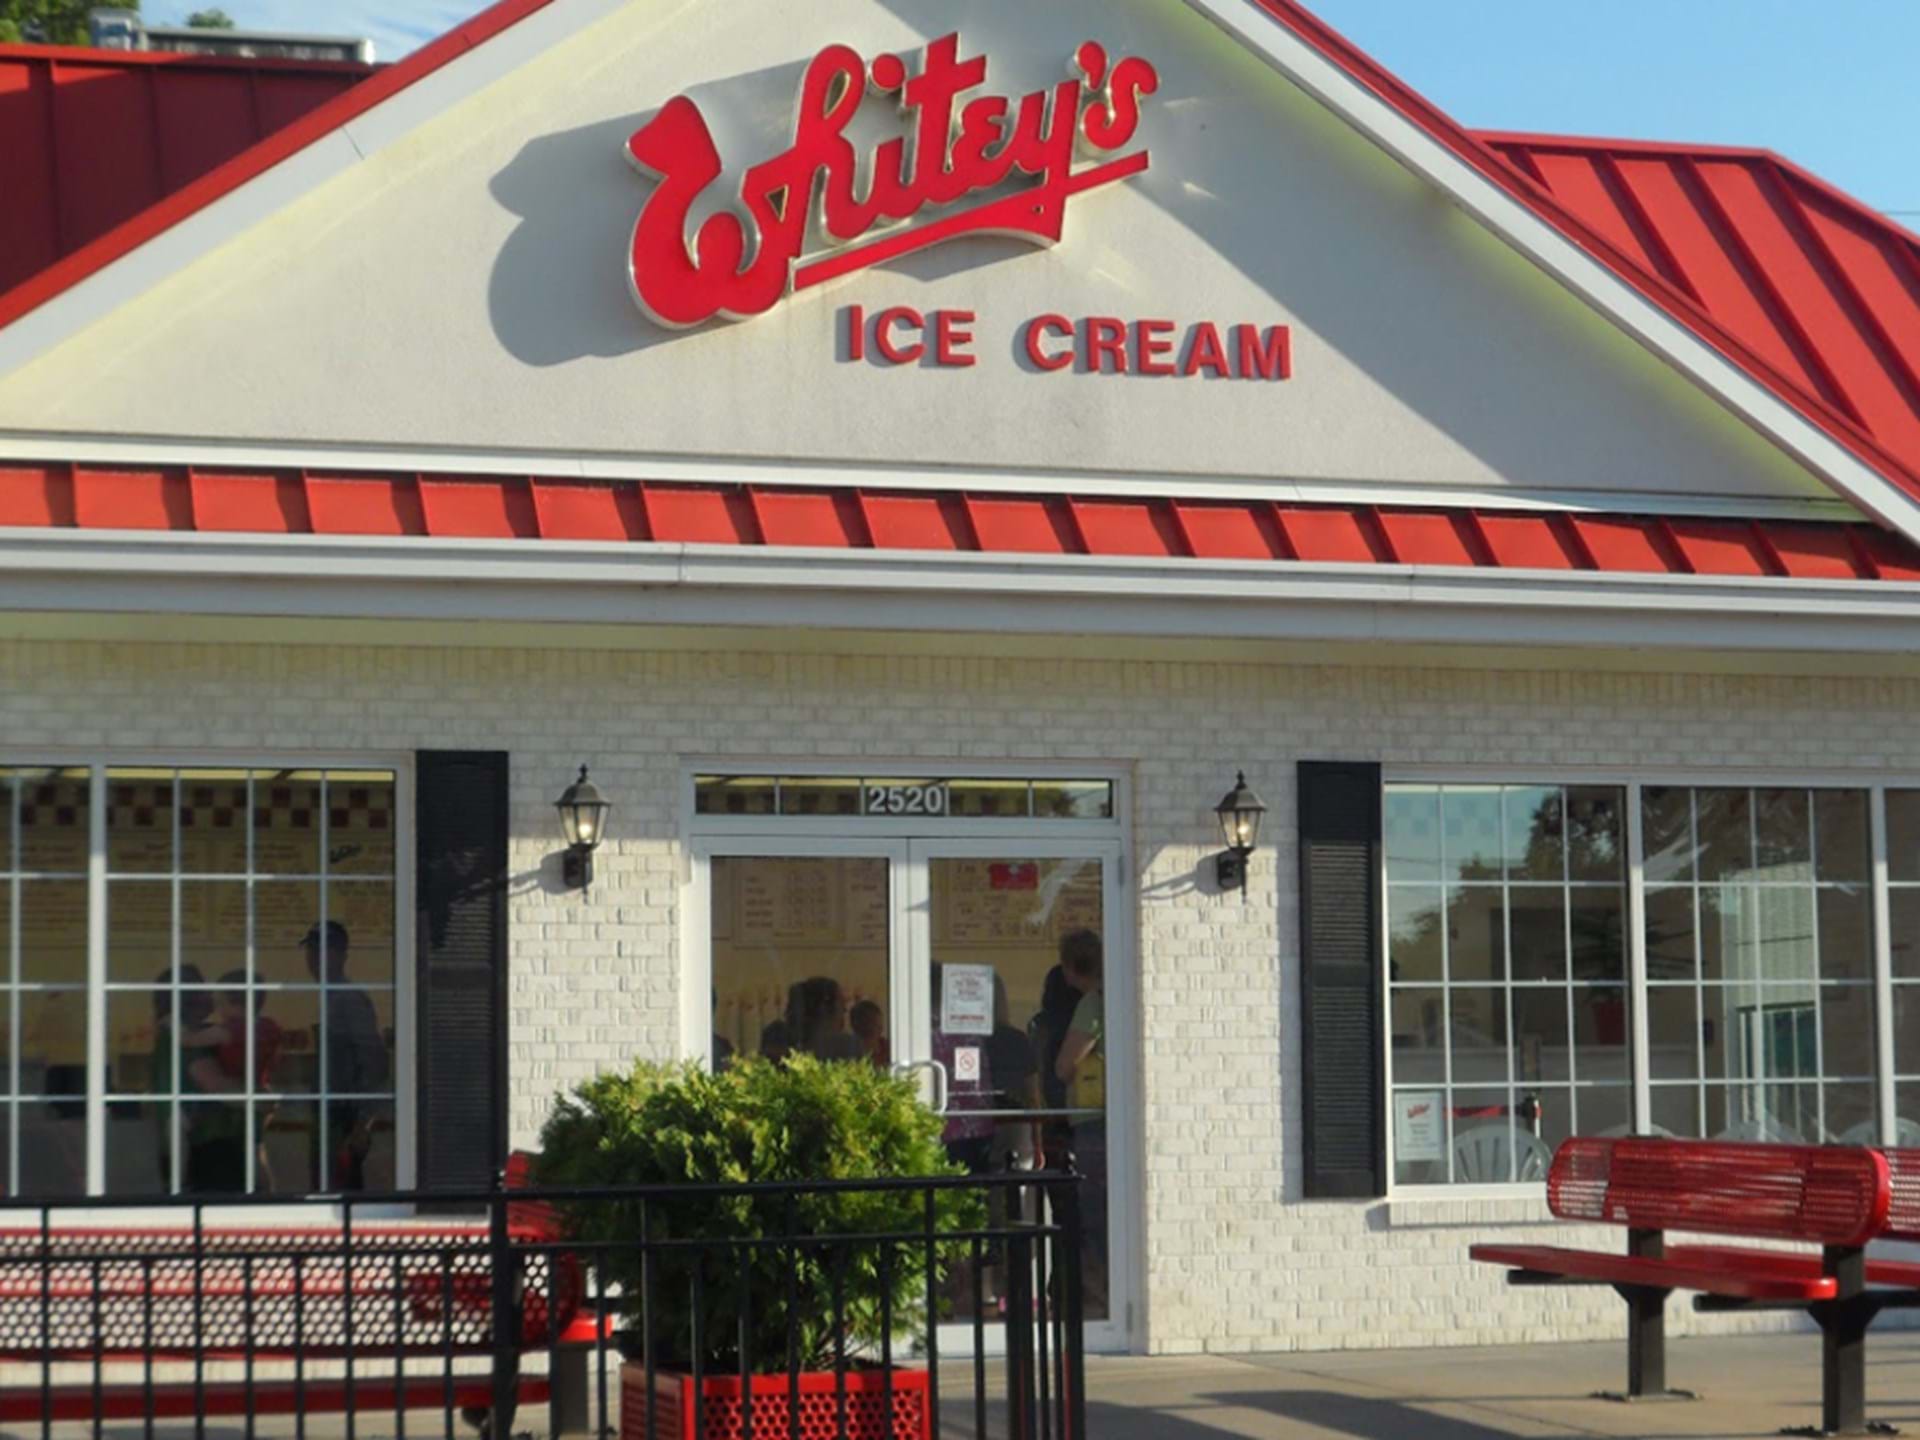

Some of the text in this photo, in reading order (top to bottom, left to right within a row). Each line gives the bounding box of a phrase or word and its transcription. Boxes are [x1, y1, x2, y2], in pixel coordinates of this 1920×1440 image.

[626, 32, 1160, 329] Whitey's
[847, 305, 1292, 381] ICE CREAM
[868, 786, 943, 814] 2520
